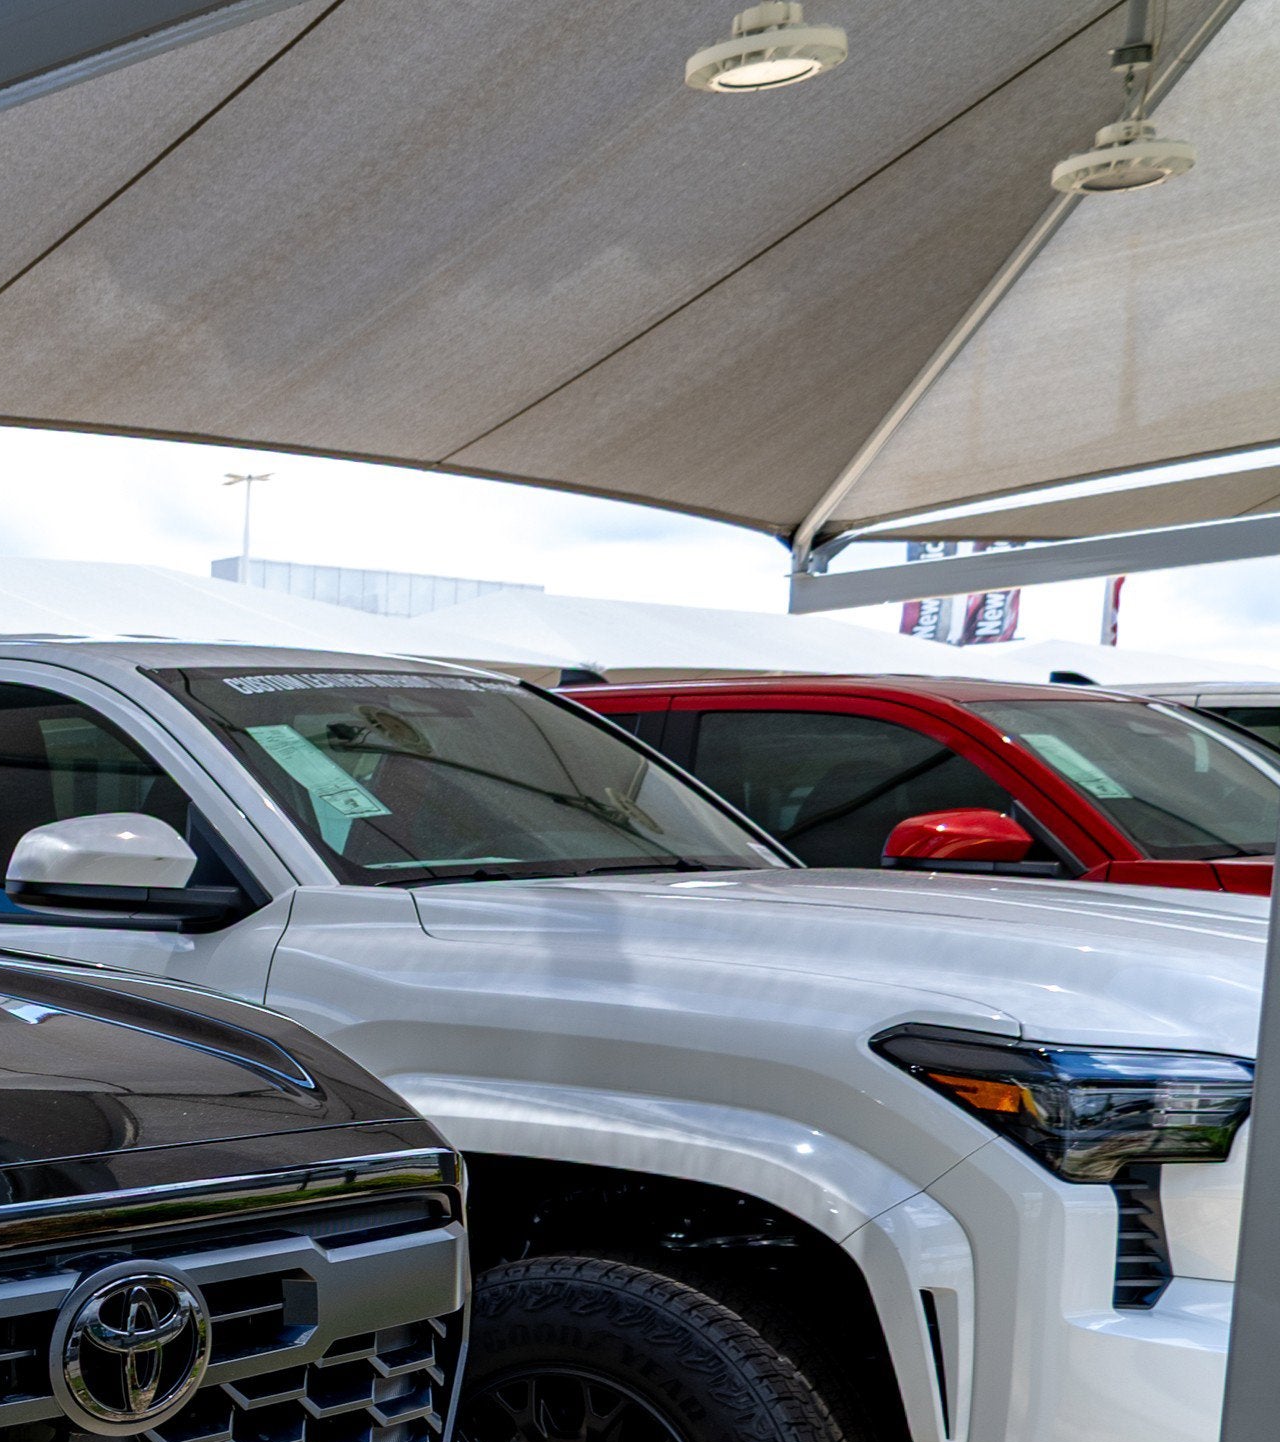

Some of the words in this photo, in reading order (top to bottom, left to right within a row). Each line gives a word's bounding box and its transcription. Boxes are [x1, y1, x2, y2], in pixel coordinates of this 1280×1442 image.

[913, 598, 941, 639] New
[975, 592, 1006, 636] New
[223, 674, 311, 695] CUSTOM
